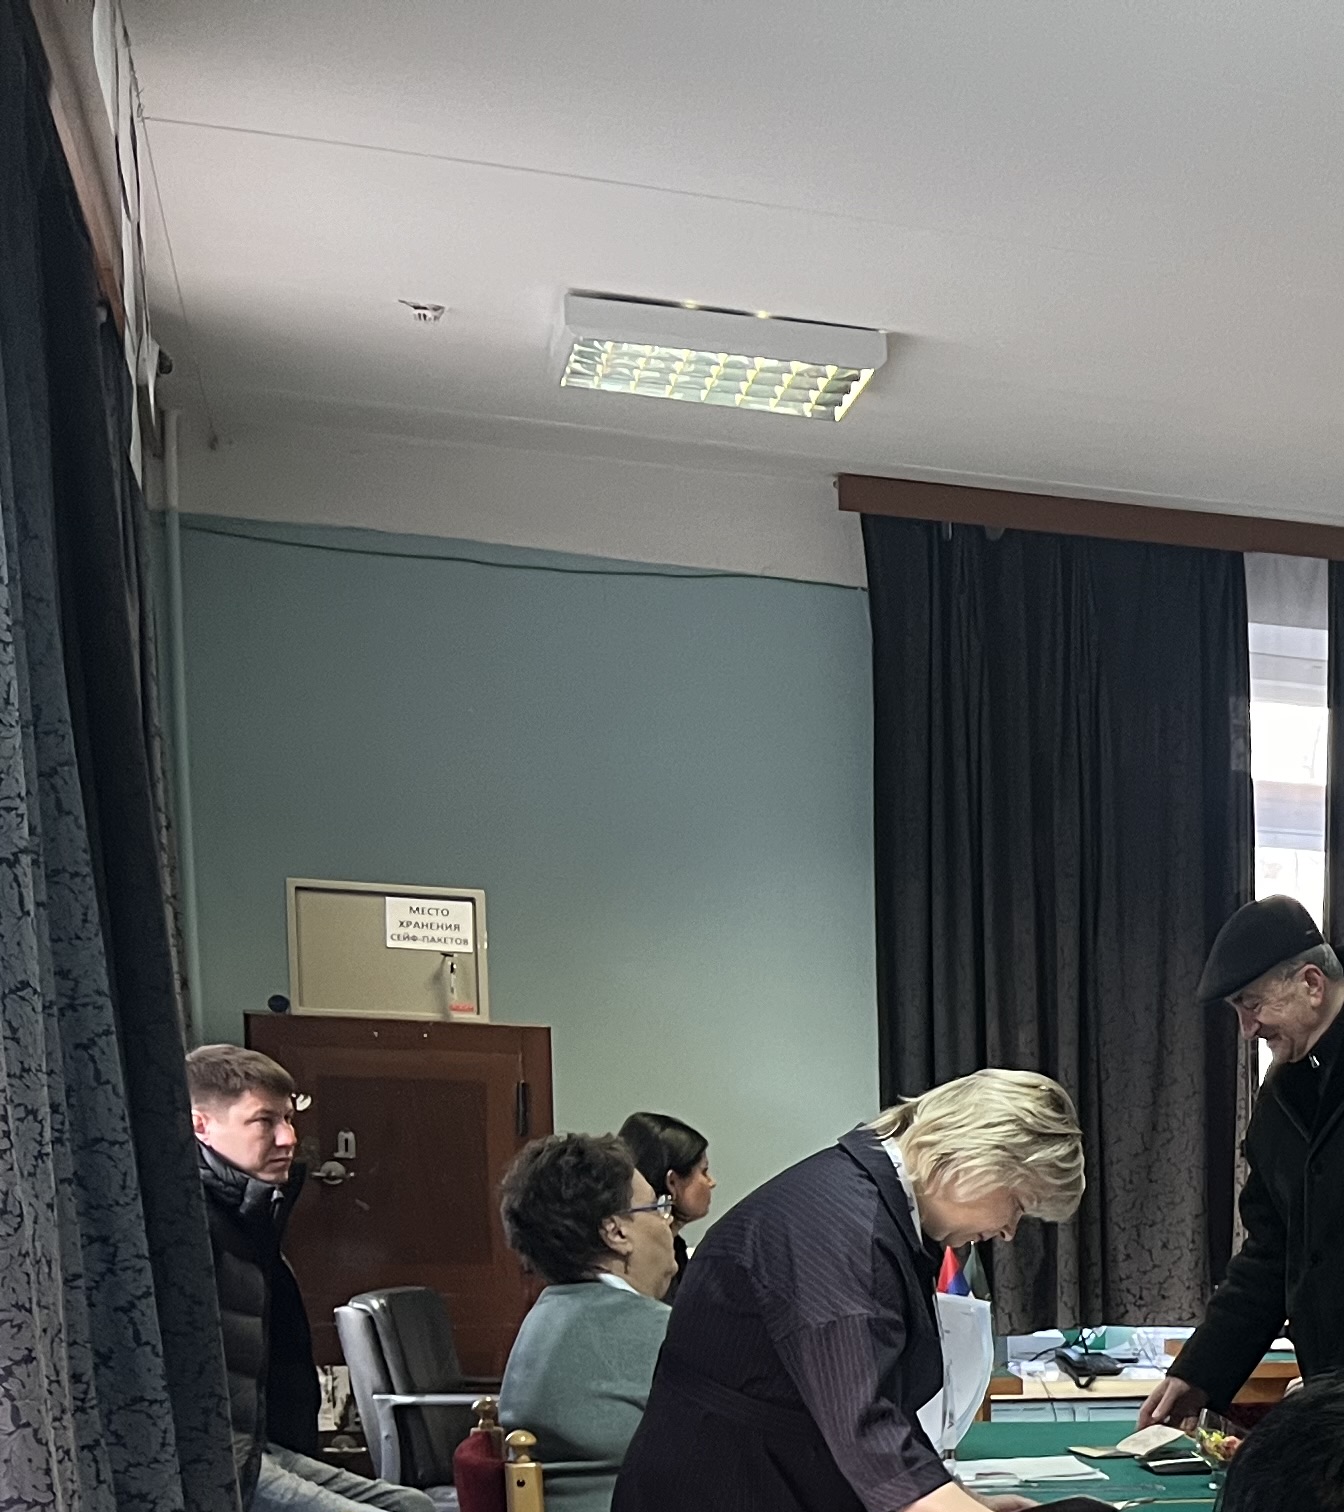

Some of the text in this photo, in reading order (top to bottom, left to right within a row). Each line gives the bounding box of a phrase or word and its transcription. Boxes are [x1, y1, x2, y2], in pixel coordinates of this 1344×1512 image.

[409, 906, 450, 917] МЕСТО
[398, 920, 461, 932] ХРАНЕНИЯ
[390, 932, 469, 946] СЕЙФ-ПАКЕТОВ
